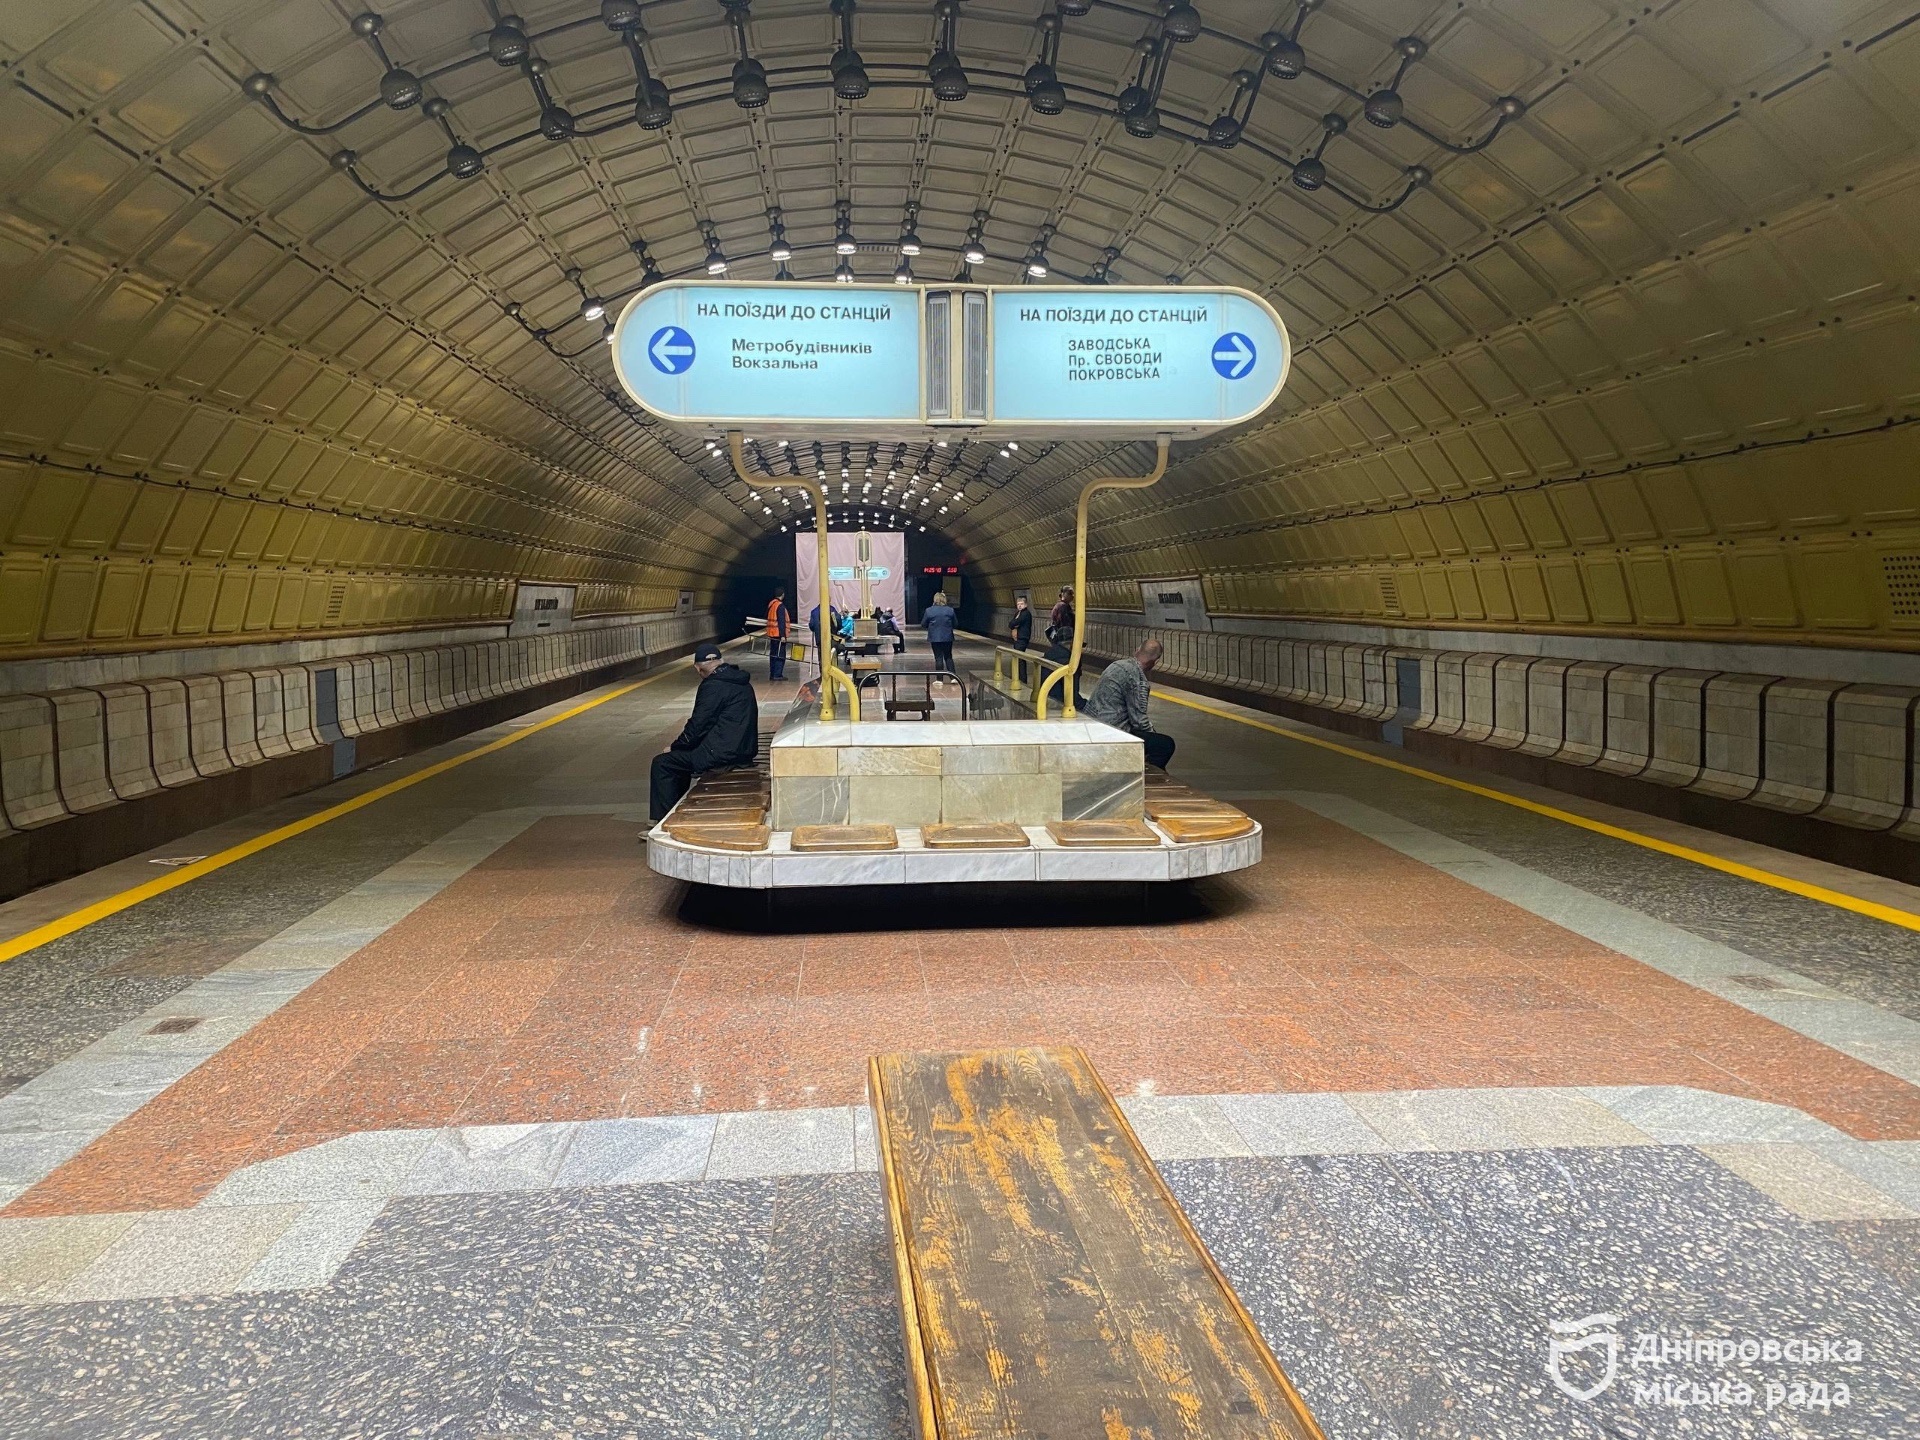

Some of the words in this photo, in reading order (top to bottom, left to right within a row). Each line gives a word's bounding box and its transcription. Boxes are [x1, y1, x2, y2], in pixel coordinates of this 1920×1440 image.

[697, 302, 720, 317] НА
[724, 302, 787, 320] ПОЇЗДИ
[790, 305, 815, 321] ДО
[820, 304, 891, 322] СТАНЦІЙ
[1020, 308, 1041, 322] НА
[1046, 306, 1106, 323] ПОЇЗДИ
[1109, 309, 1133, 324] ДО
[1138, 306, 1207, 324] СТАНЦІЙ
[731, 339, 872, 355] Метробудівників
[1068, 338, 1151, 352] ЗАВОДСЬКА
[731, 356, 819, 369] Вокзальна
[1068, 355, 1090, 367] Пр.
[1095, 353, 1162, 366] СВОБОДИ
[1068, 367, 1161, 380] ПОКРОВСЬКА
